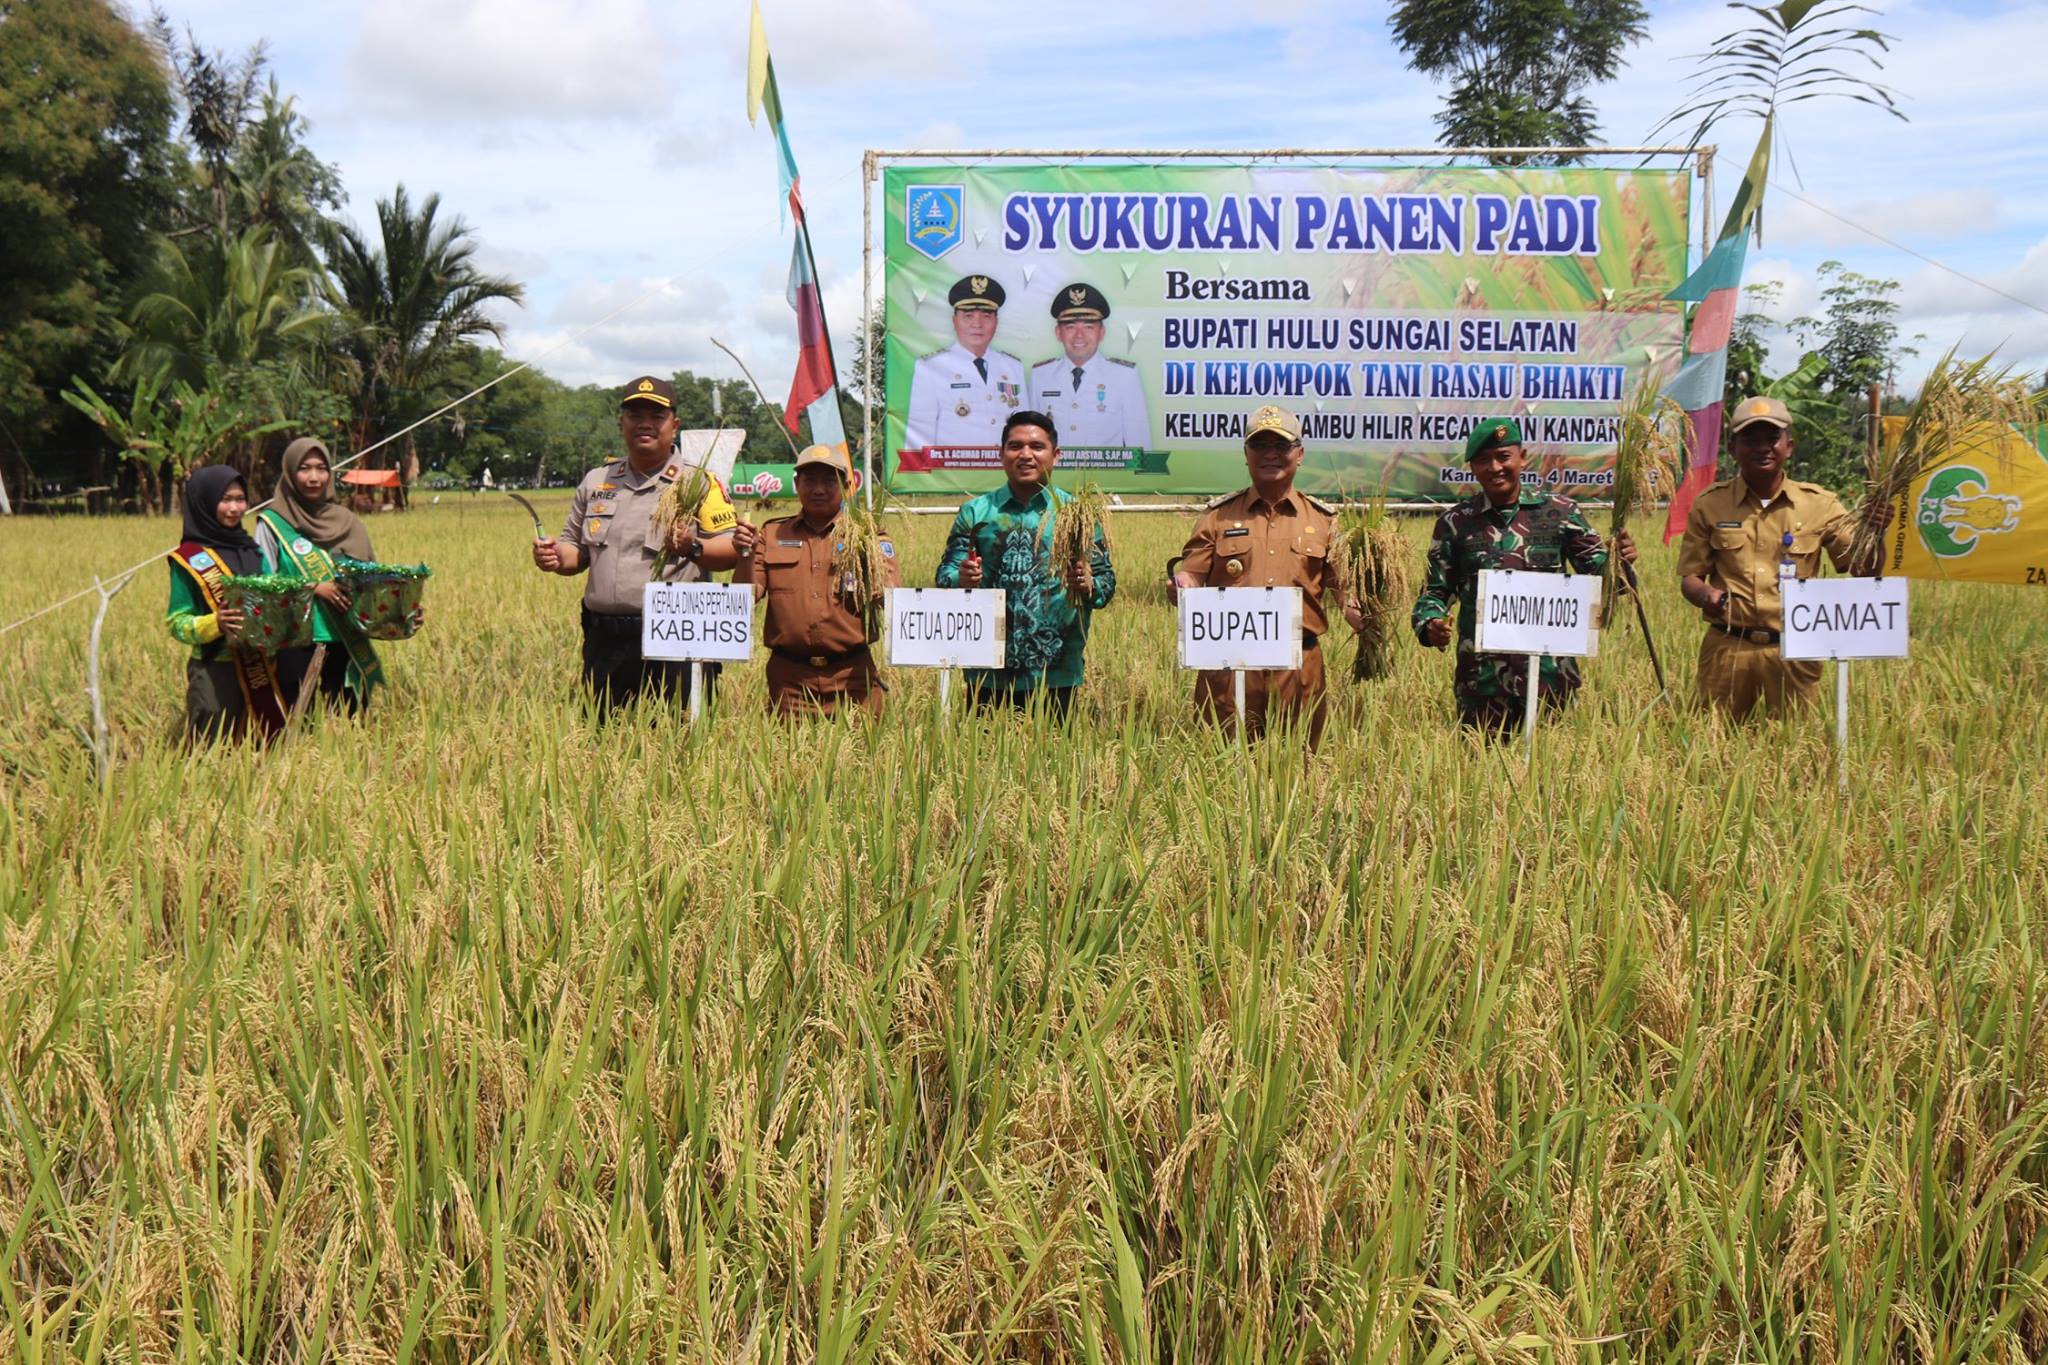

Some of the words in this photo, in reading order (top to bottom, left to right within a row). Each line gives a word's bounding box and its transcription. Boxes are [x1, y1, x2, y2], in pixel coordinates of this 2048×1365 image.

[1005, 195, 1282, 251] SYUKURAN
[1295, 197, 1463, 252] PANEN
[1476, 198, 1597, 252] PADI
[1166, 271, 1311, 301] Bersama
[1165, 318, 1257, 348] BUPATI
[1267, 319, 1339, 349] HULU
[1348, 319, 1450, 350] SUNGAI
[1460, 320, 1576, 352] SELATAN
[1165, 362, 1195, 395] DI
[1204, 362, 1352, 396] KELOMPOK
[1362, 363, 1422, 397] TANI
[1430, 363, 1514, 398] RASAU
[1522, 365, 1624, 400] BHAKTI
[1296, 414, 1356, 439] AMBU
[1362, 415, 1413, 440] HILIR
[1548, 470, 1558, 483] 4
[1564, 470, 1613, 484] Maret
[652, 590, 681, 615] KEPALA
[682, 591, 706, 616] DINAS
[706, 591, 748, 617] PERTANIAN
[1491, 593, 1545, 627] DANDIM
[1547, 596, 1579, 629] 1003
[1791, 601, 1901, 633] CAMAT
[651, 619, 748, 643] KAB.HSS
[900, 611, 943, 640] KETUA
[947, 612, 983, 642] DPRD
[1192, 611, 1279, 641] BUPATI
